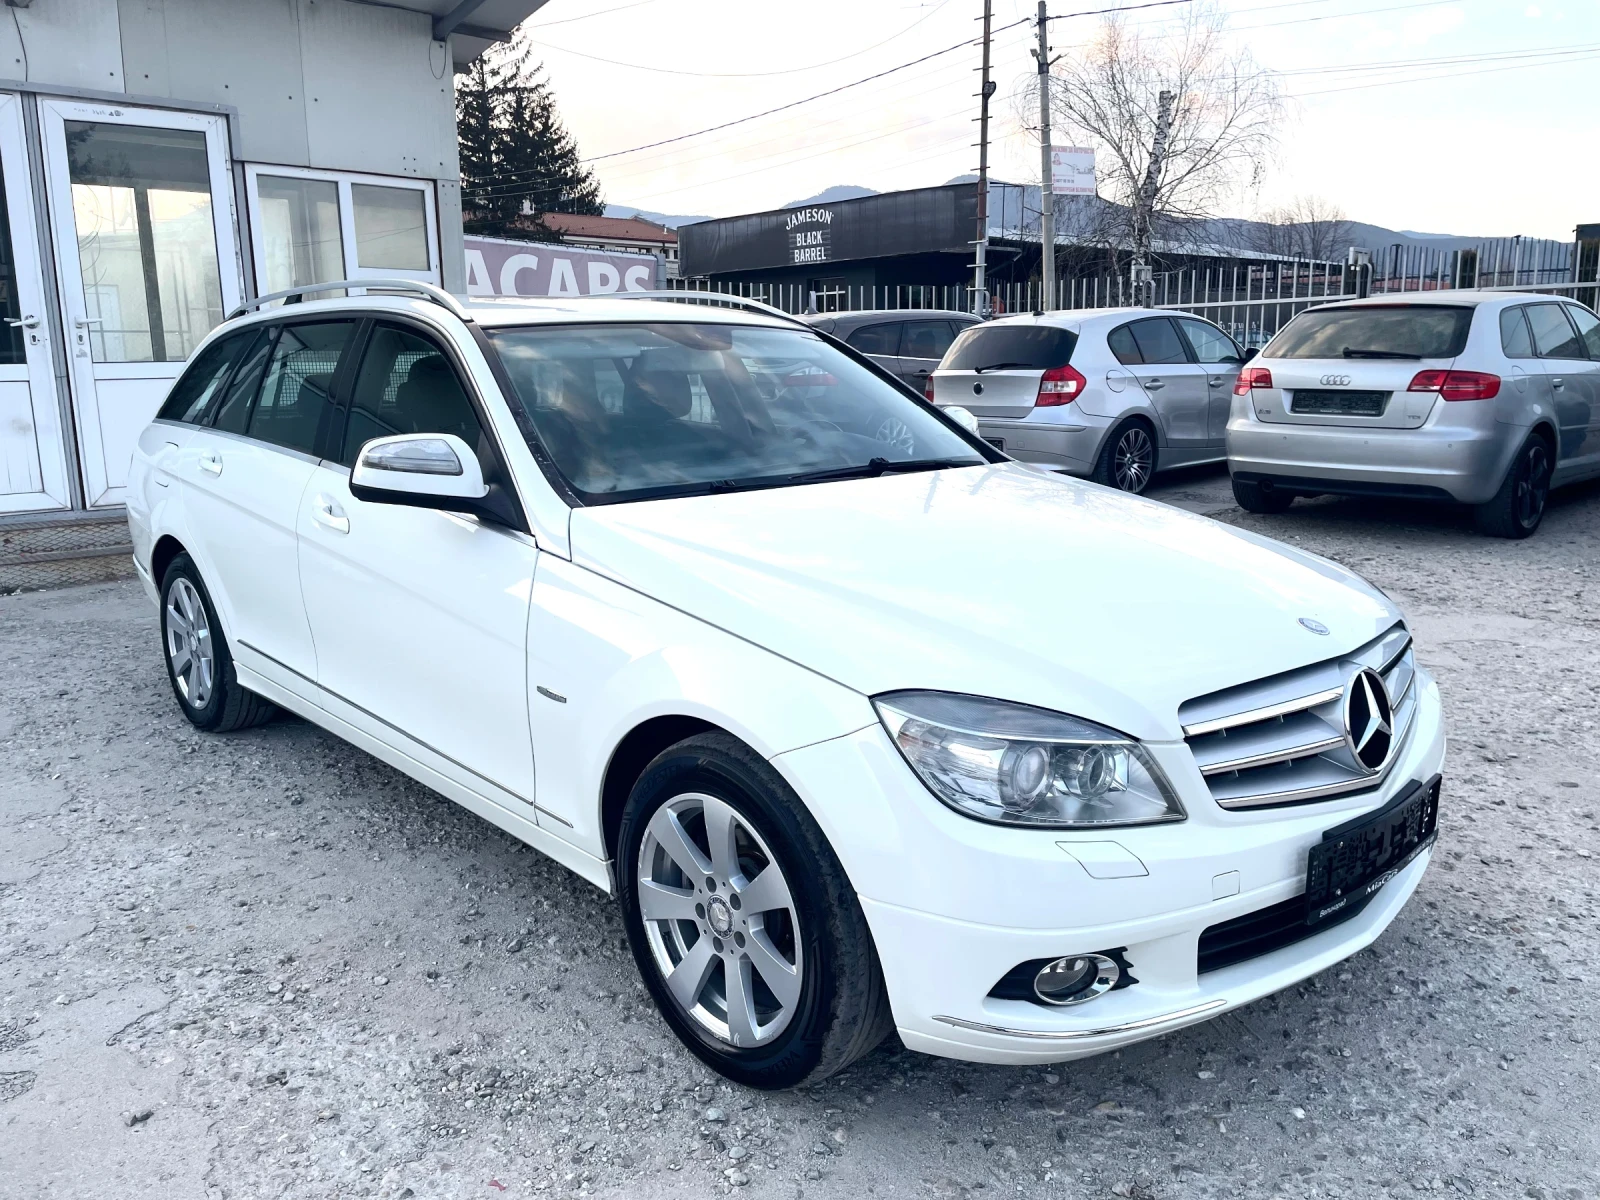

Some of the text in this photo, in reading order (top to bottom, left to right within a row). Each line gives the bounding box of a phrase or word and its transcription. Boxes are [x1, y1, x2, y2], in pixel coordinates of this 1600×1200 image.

[786, 208, 832, 230] JAMESON
[796, 230, 823, 246] BLACK
[794, 247, 826, 262] BARREL
